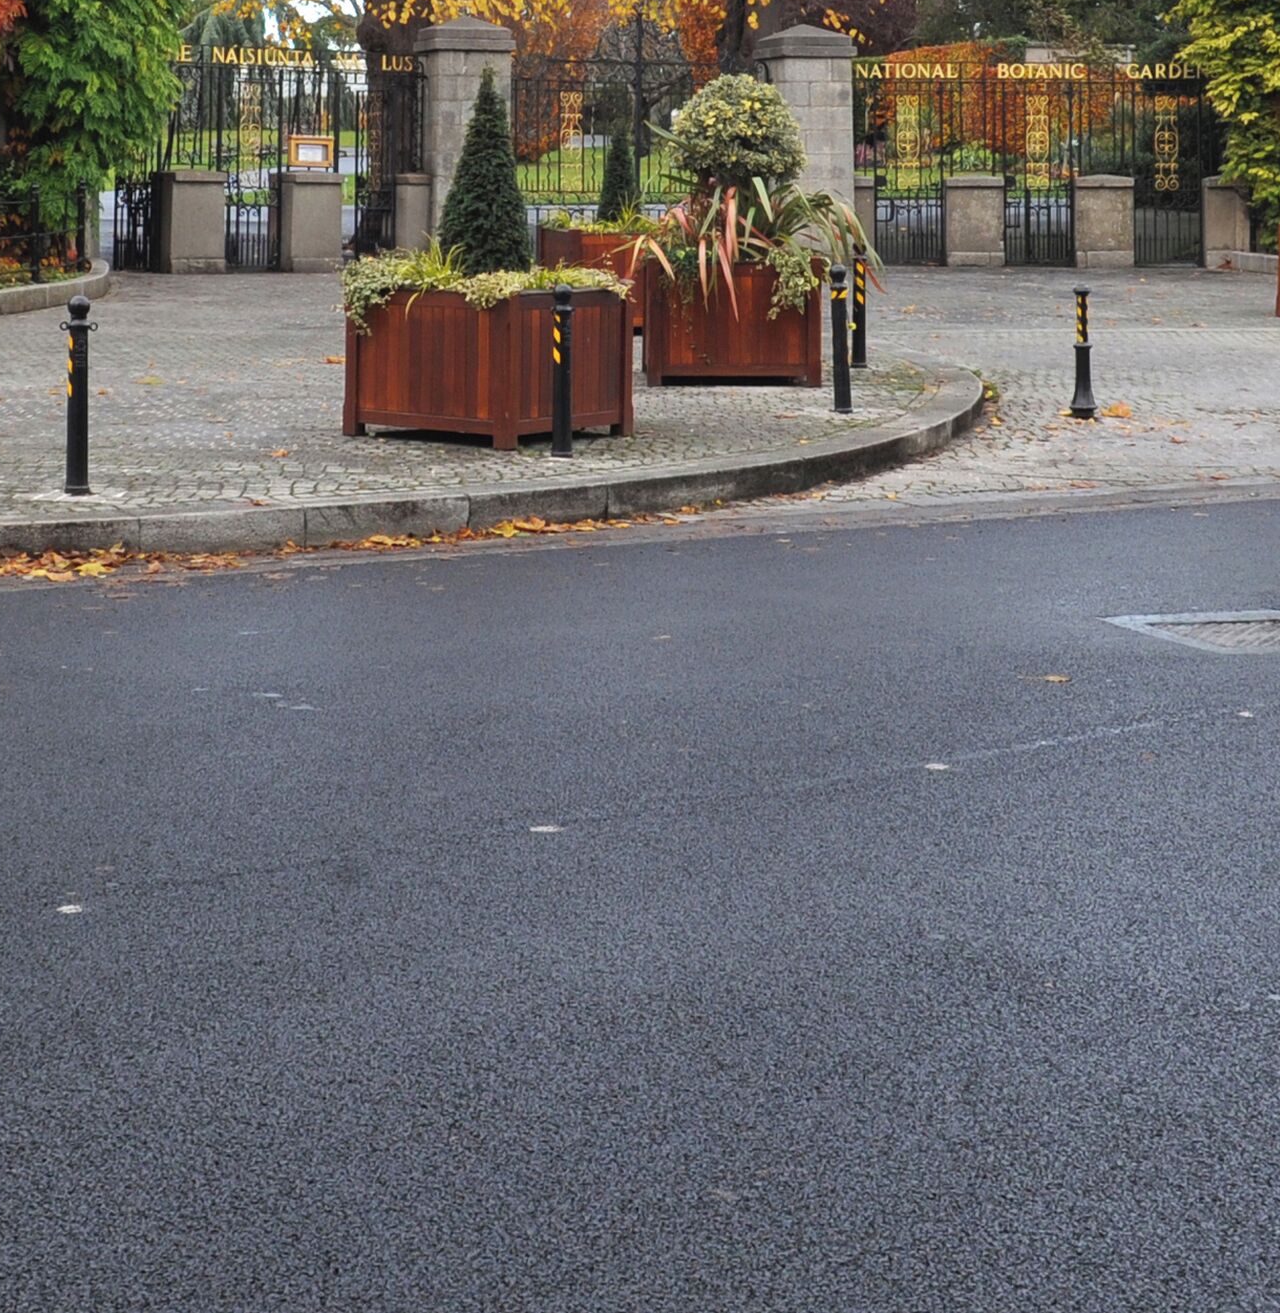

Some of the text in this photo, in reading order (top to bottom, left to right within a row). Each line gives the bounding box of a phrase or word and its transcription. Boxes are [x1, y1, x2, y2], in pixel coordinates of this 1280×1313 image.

[336, 52, 361, 70] NA
[381, 54, 414, 71] LUS
[855, 63, 959, 79] NATIONAL
[997, 63, 1086, 79] BOTANIC
